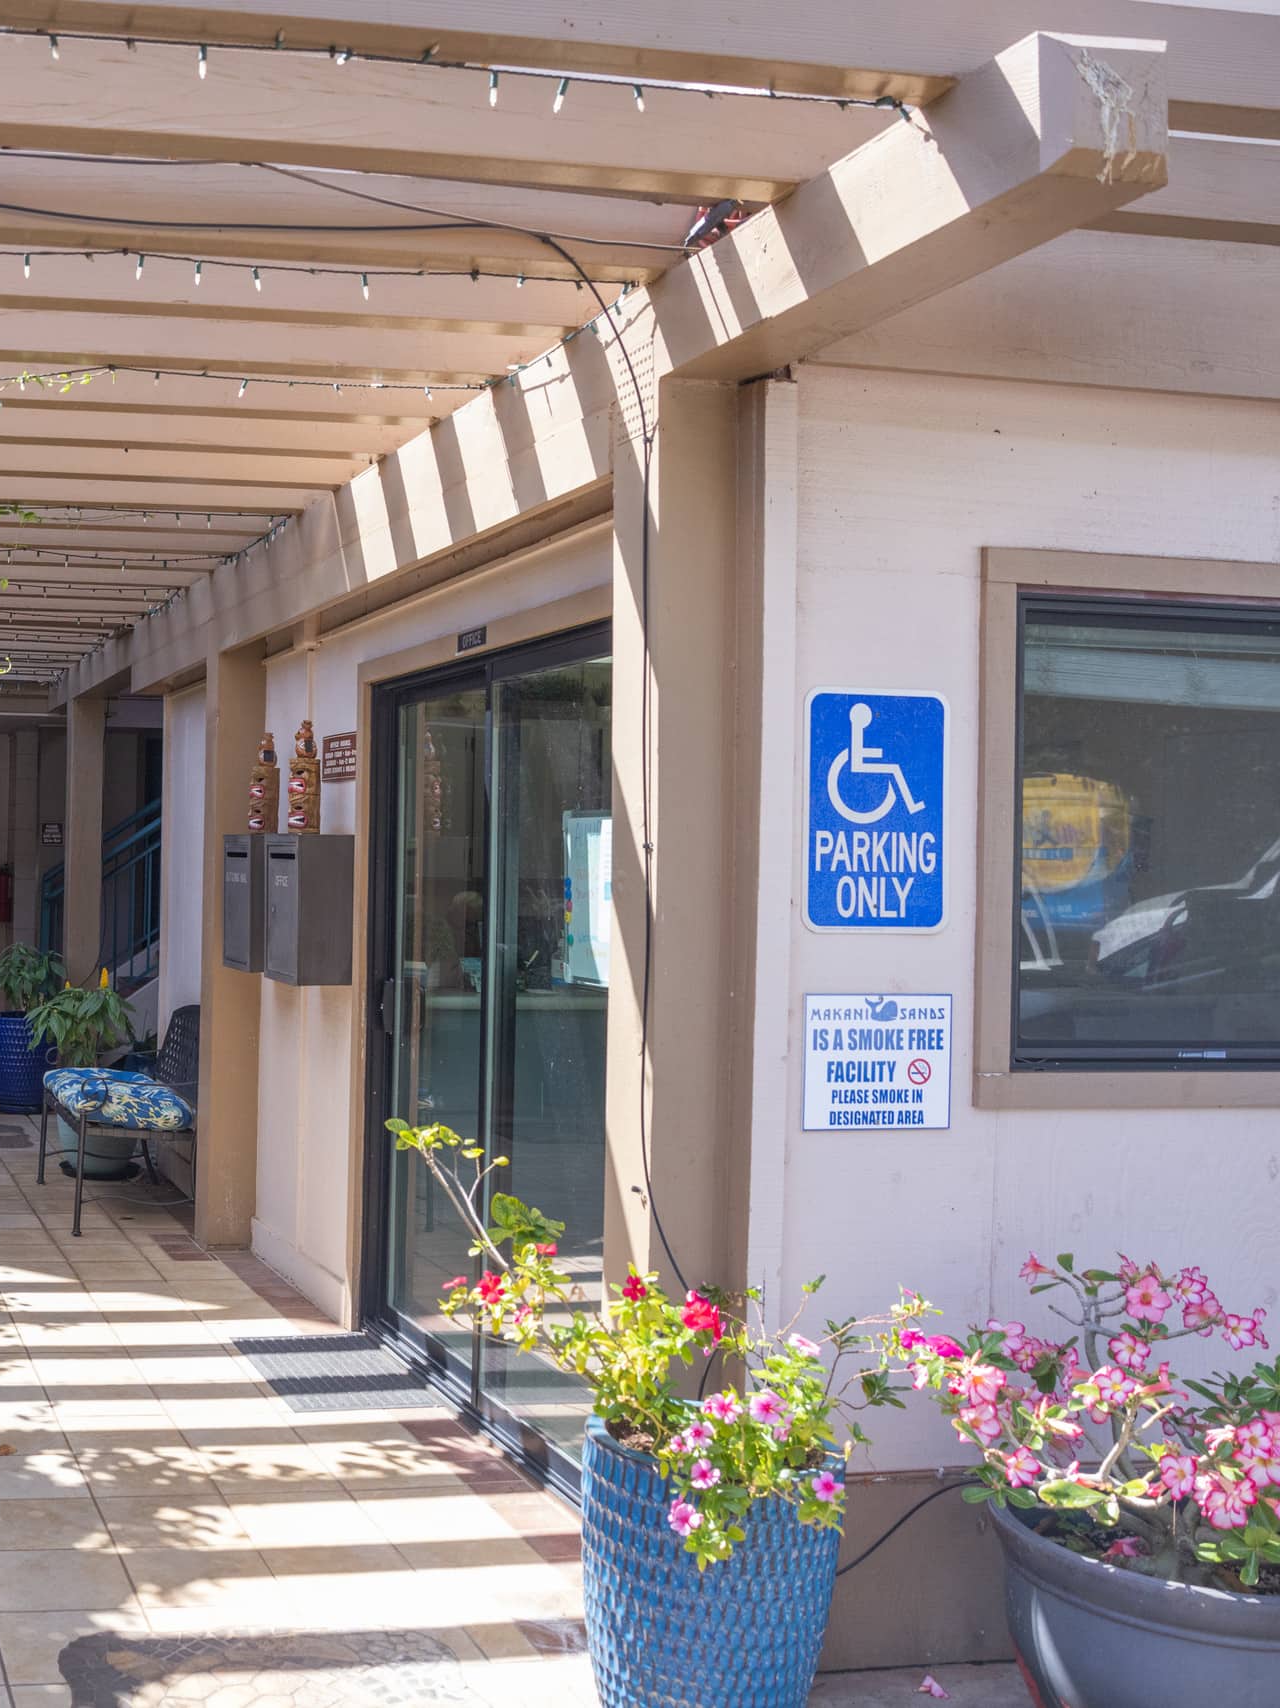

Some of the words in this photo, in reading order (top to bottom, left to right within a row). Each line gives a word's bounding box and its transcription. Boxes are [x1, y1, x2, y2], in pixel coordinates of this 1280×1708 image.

[462, 631, 482, 648] OFFICE
[815, 830, 937, 874] PARKING
[836, 875, 914, 918] ONLY
[810, 1007, 869, 1021] MAKANI
[899, 1007, 945, 1020] SANDS
[812, 1028, 829, 1051] IS
[832, 1028, 844, 1051] A
[847, 1028, 904, 1051] SMOKE
[908, 1028, 944, 1051] FREE
[826, 1060, 897, 1083] FACILITY
[831, 1089, 869, 1104] PLEASE
[871, 1089, 909, 1104] SMOKE
[912, 1089, 923, 1103] IN
[829, 1110, 895, 1126] DESIGNATED
[897, 1110, 924, 1125] AREA
